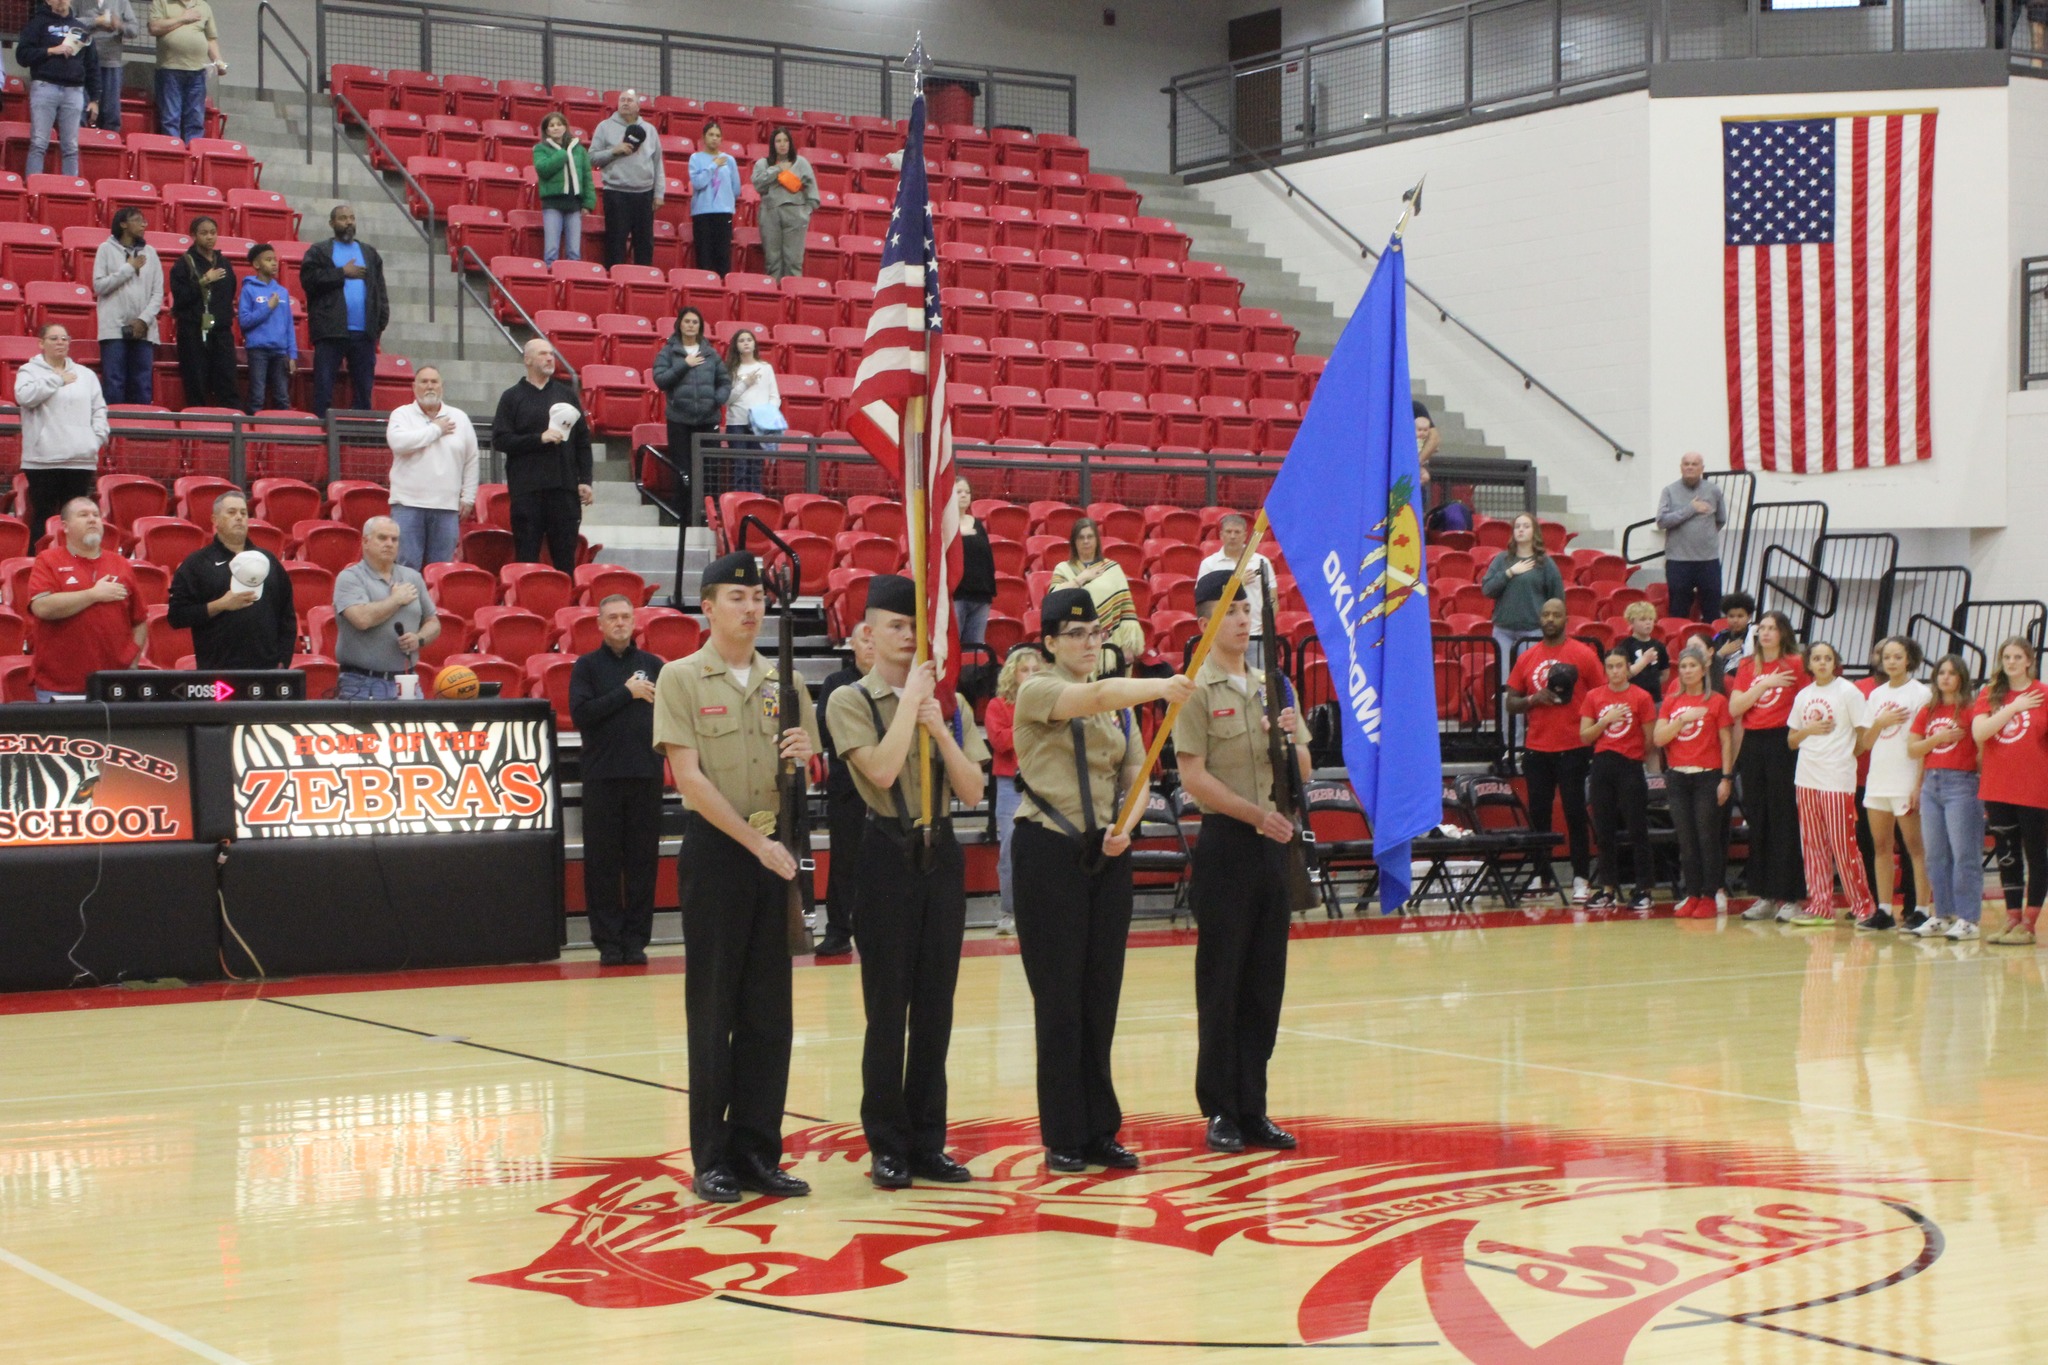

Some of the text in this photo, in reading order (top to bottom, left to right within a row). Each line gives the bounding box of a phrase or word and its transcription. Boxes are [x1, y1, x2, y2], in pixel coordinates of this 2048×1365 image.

[113, 685, 289, 698] B B POSS B B
[293, 731, 490, 755] HOME OF THE
[242, 762, 546, 824] ZEBRAS
[0, 806, 179, 842] SCHOOL
